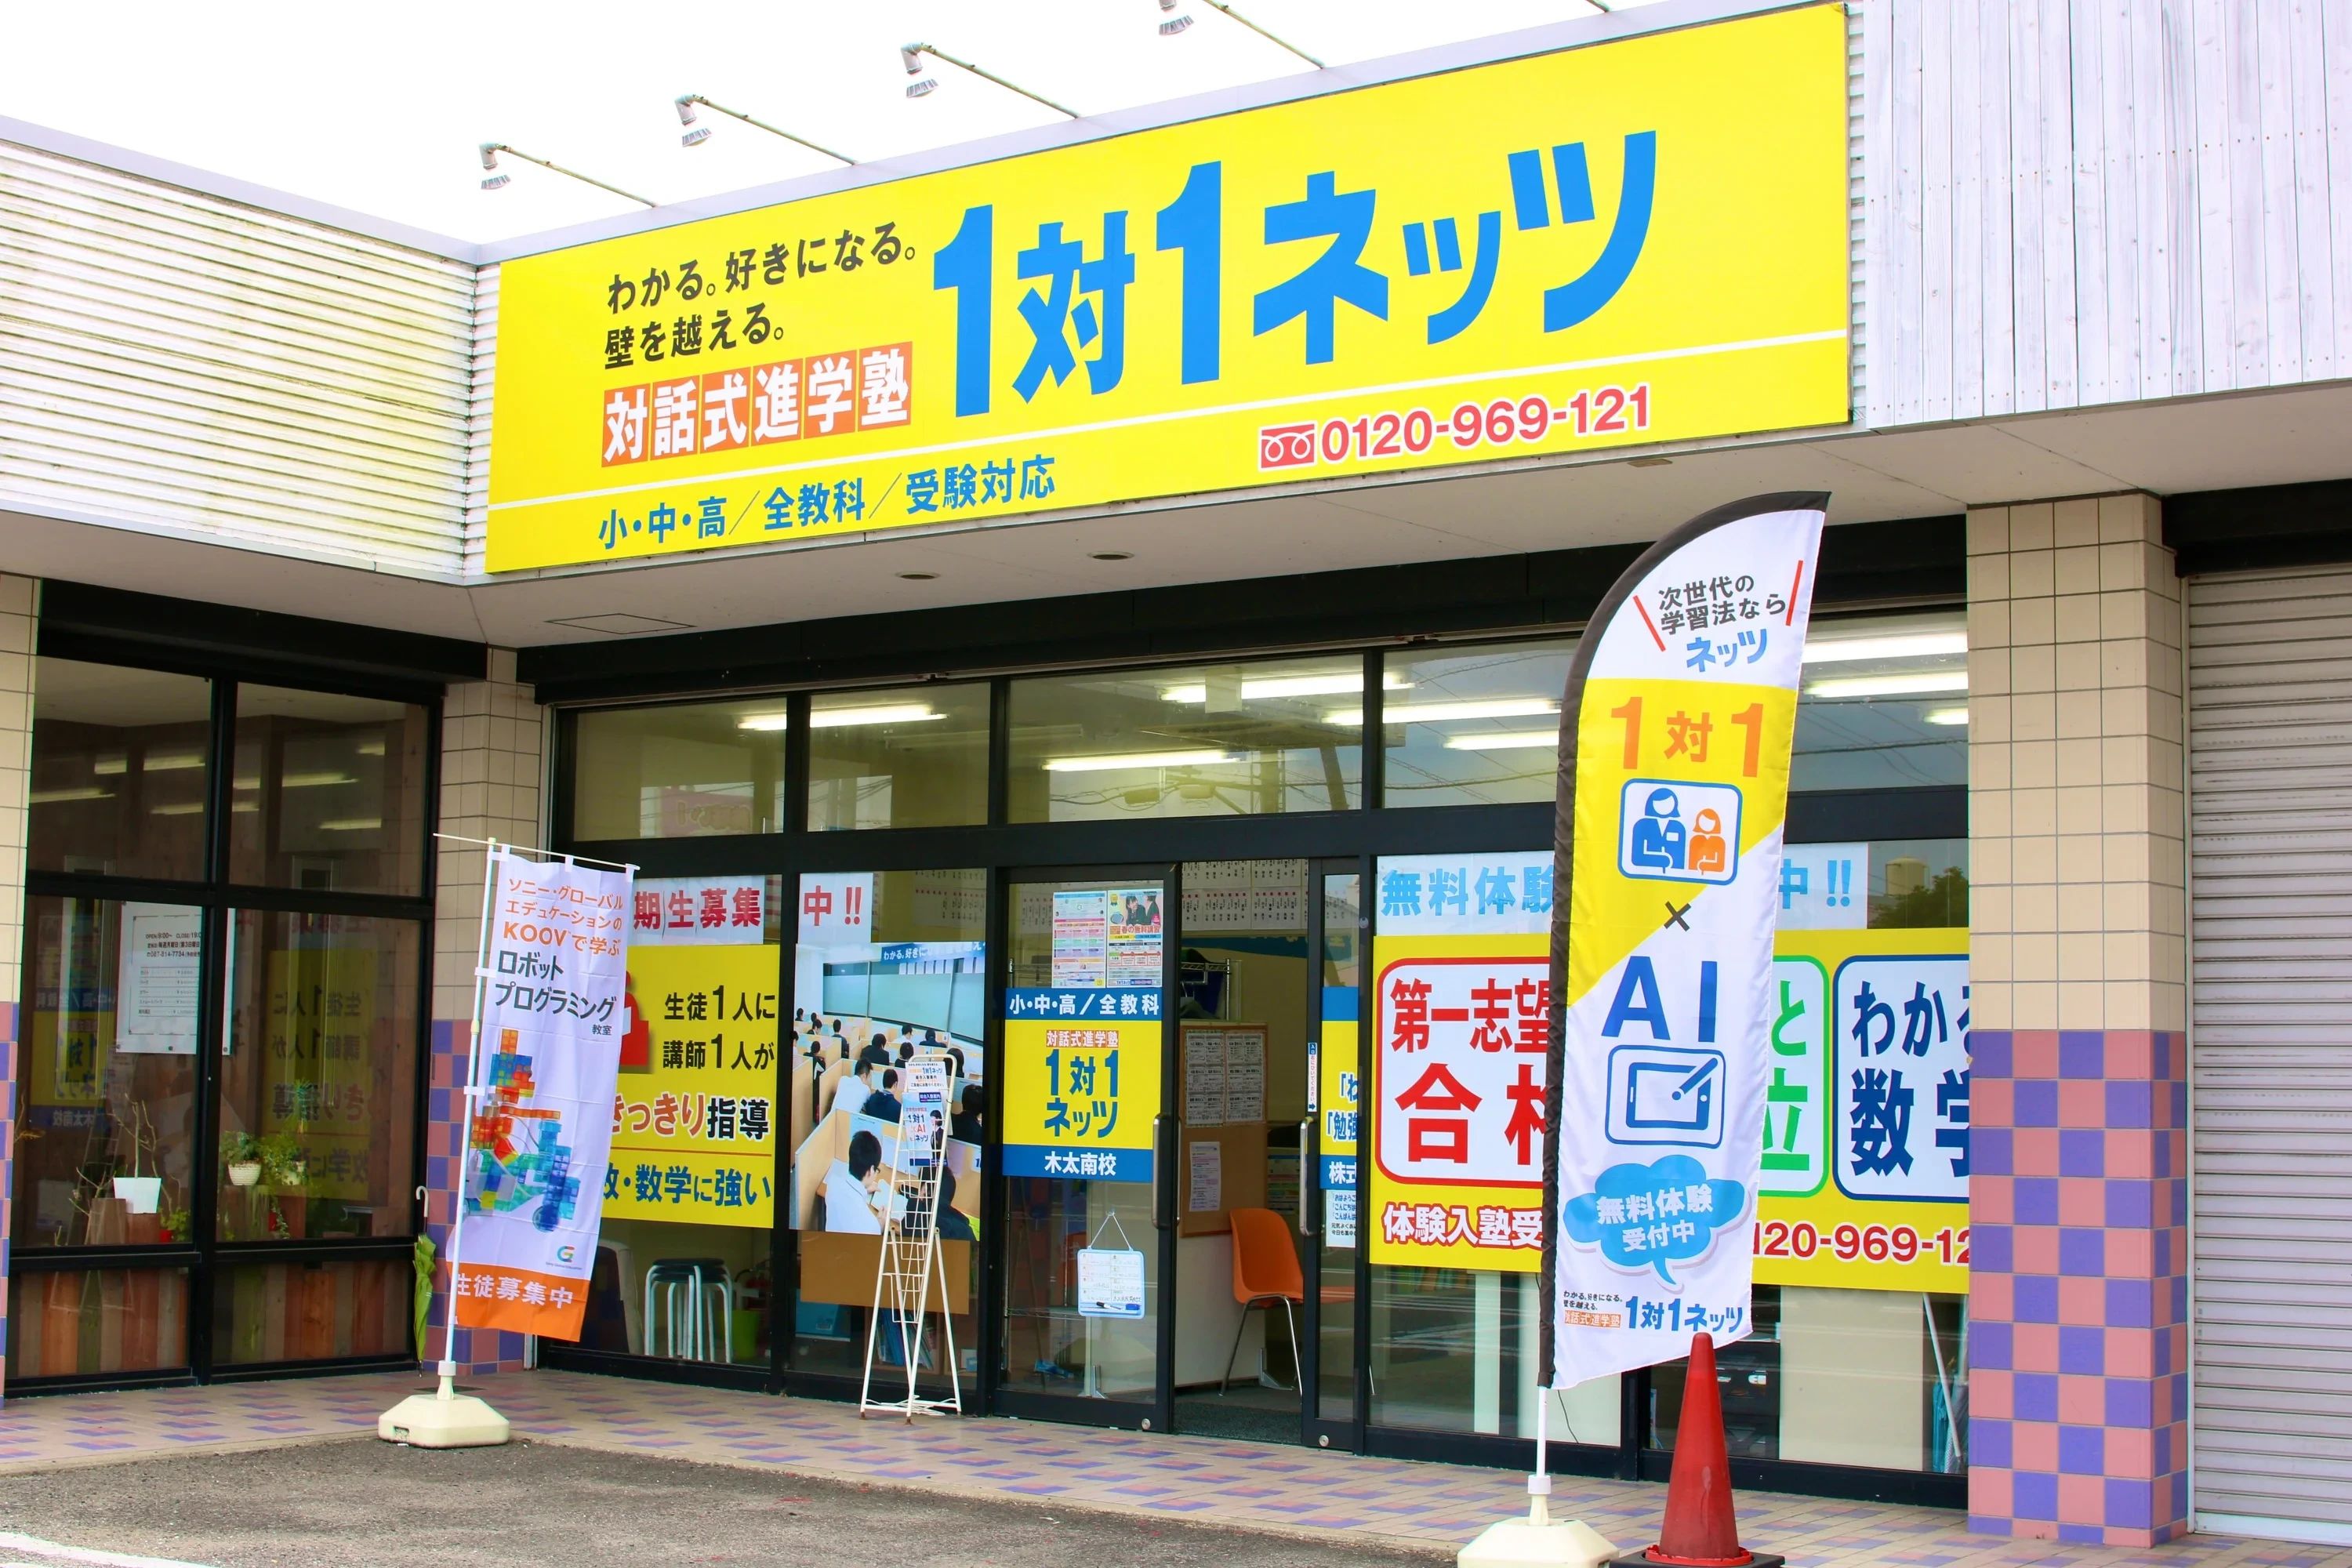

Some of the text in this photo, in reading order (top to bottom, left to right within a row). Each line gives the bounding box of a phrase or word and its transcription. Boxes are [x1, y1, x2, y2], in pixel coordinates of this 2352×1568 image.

[933, 129, 1657, 418] 1対1ネッツ
[604, 303, 785, 369] 壁を越える。
[603, 346, 910, 465] 対話式進学塾
[1321, 385, 1650, 463] 0120-969-121
[1658, 574, 1755, 611] 次世代の
[1661, 593, 1786, 635] 学習法なら
[1686, 629, 1768, 673] ネッツ
[1611, 696, 1764, 779] 1対1
[509, 878, 623, 909] ソニー・グローバル
[633, 887, 761, 931] 期生募集
[1381, 865, 1553, 916] 無料体験
[506, 900, 622, 931] エデュケーションの
[498, 949, 564, 981] ロボット
[495, 982, 617, 1021] プログラミング
[663, 985, 775, 1021] 生徒1人に
[1390, 978, 1550, 1054] 第一志望
[1601, 956, 1718, 1043] AI
[1770, 979, 1806, 1056] と
[1851, 980, 1969, 1057] わか
[592, 1024, 612, 1036] 教室
[1047, 1031, 1119, 1047] 対話式進学塾
[663, 1033, 775, 1071] 講師1人が
[1045, 1048, 1119, 1098] 1対1
[1044, 1098, 1118, 1138] ネッツ
[1759, 1067, 1809, 1171] 立
[1044, 1151, 1116, 1176] 木太南校
[1596, 1183, 1713, 1225] 無料体験
[1622, 1219, 1697, 1253] 受付中
[458, 1272, 573, 1309] 生徒募集中
[1625, 1296, 1743, 1334] 1対1ネッツ
